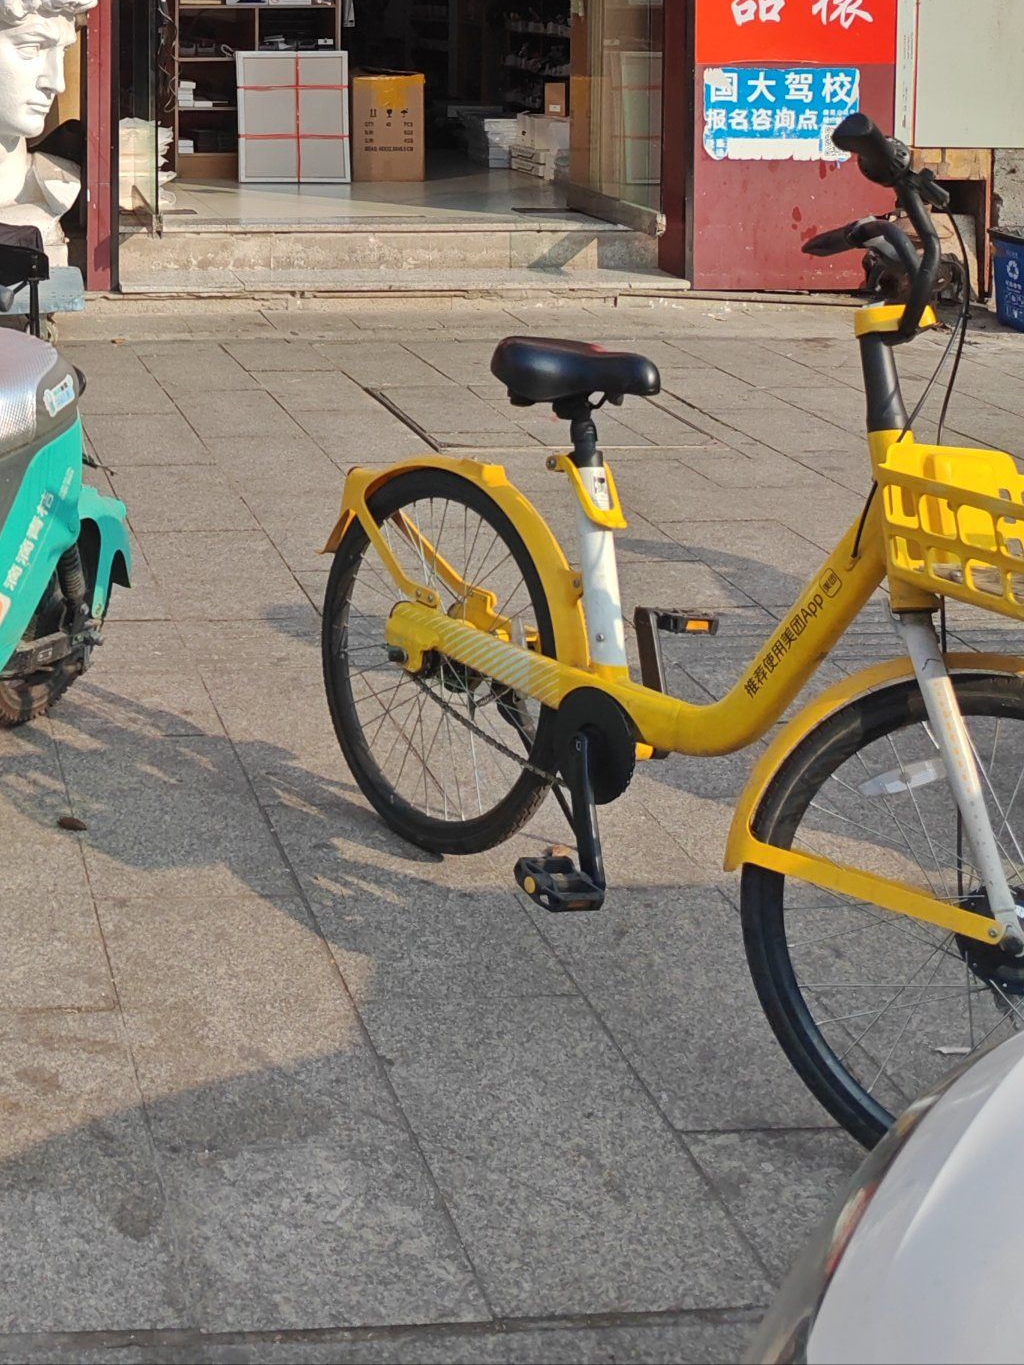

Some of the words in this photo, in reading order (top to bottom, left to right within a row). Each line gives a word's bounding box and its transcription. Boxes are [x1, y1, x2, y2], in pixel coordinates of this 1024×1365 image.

[706, 107, 818, 132] 报名咨询点
